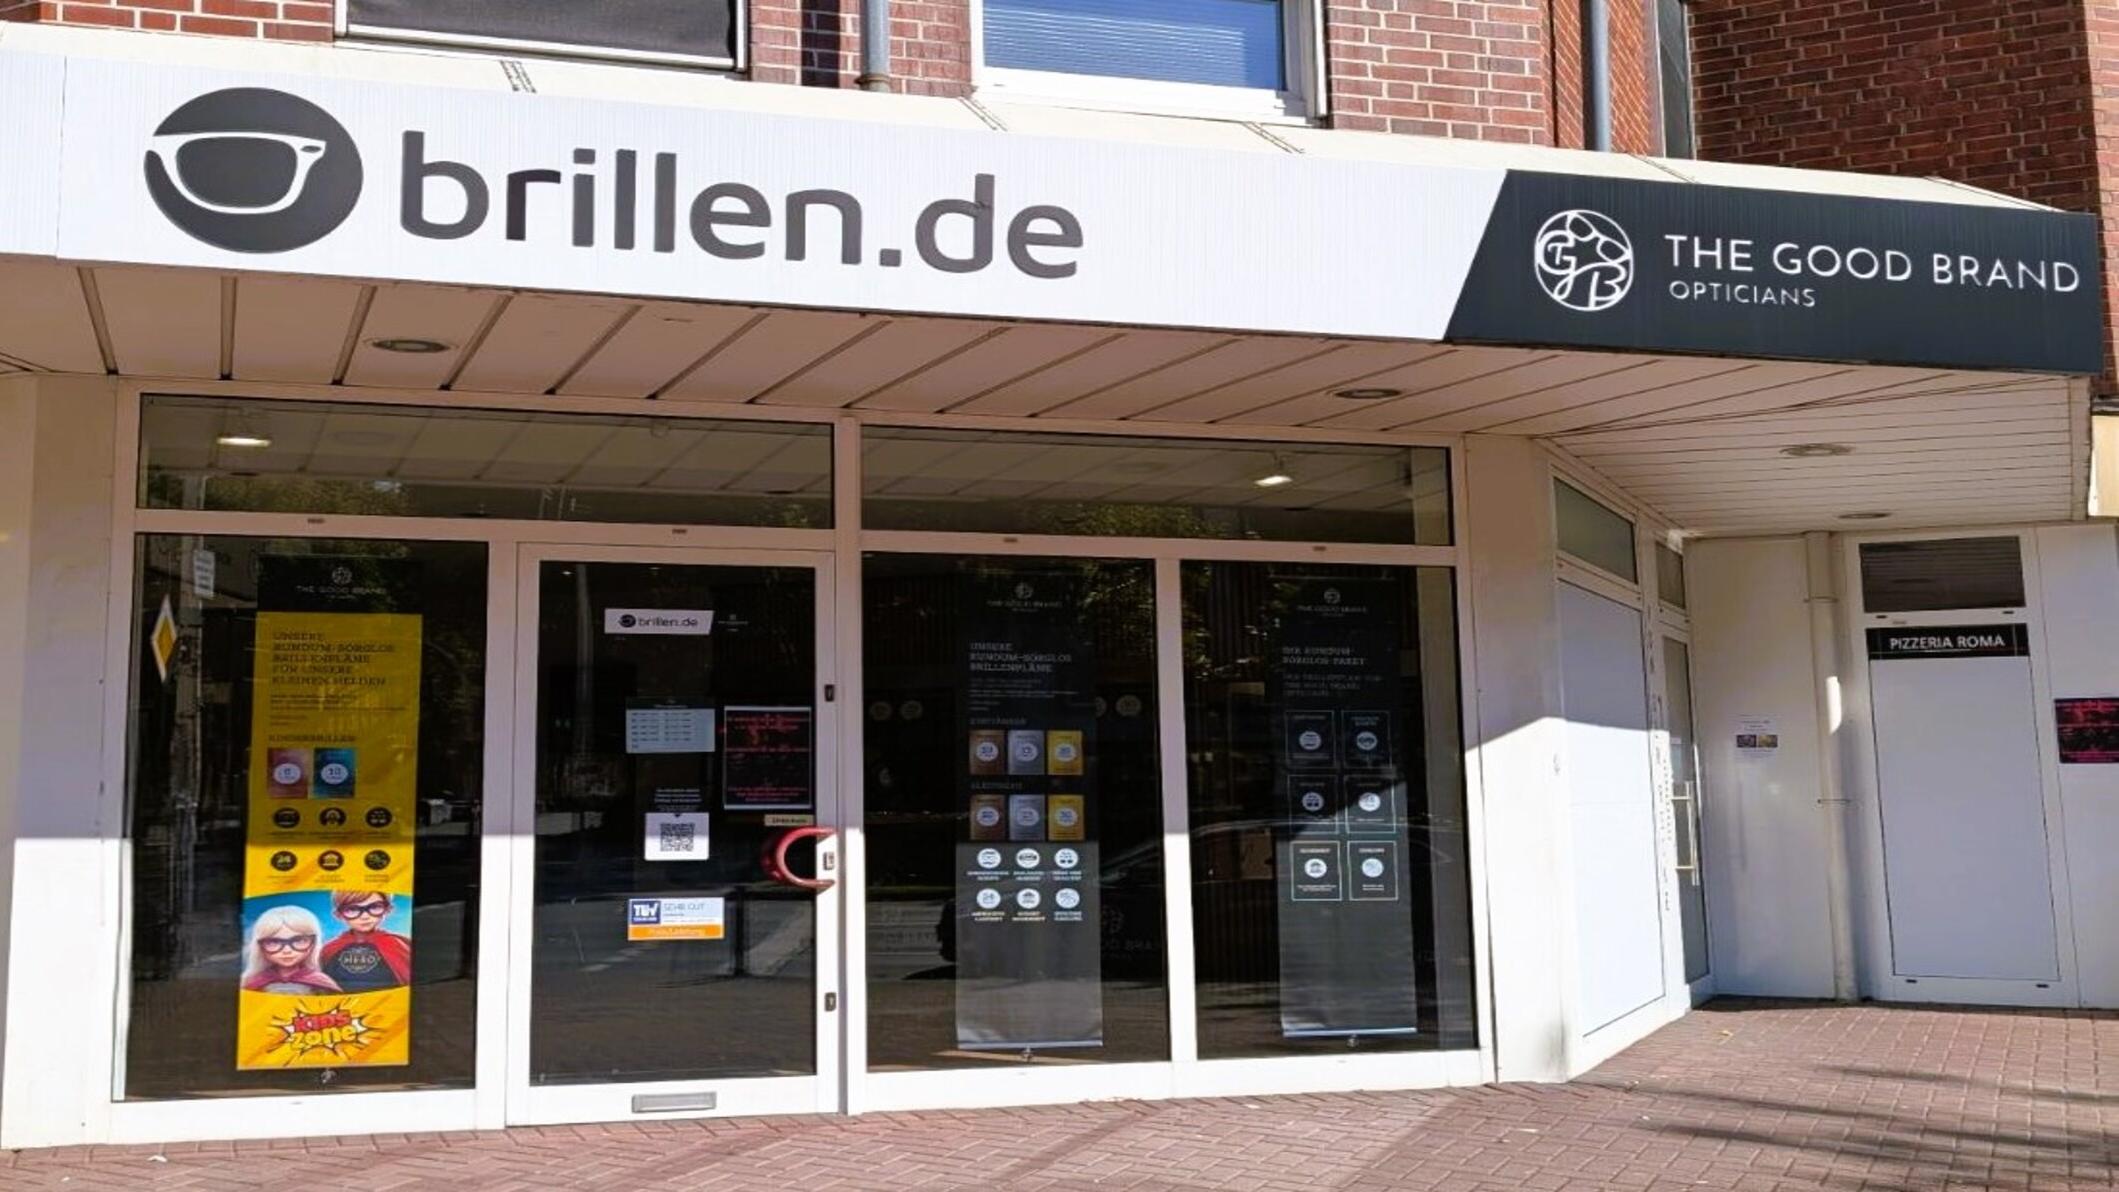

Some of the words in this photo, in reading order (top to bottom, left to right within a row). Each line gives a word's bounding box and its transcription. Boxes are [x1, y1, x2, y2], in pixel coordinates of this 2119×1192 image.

[400, 130, 1084, 280] brillen.de
[1664, 233, 1755, 272] THE
[1772, 241, 1913, 283] GOOD
[1932, 252, 2081, 294] BRAND
[1668, 279, 1817, 309] OPTICIANS
[638, 616, 699, 627] brillen.de
[1888, 636, 1954, 650] PIZZERIA
[1956, 634, 2006, 648] ROMA
